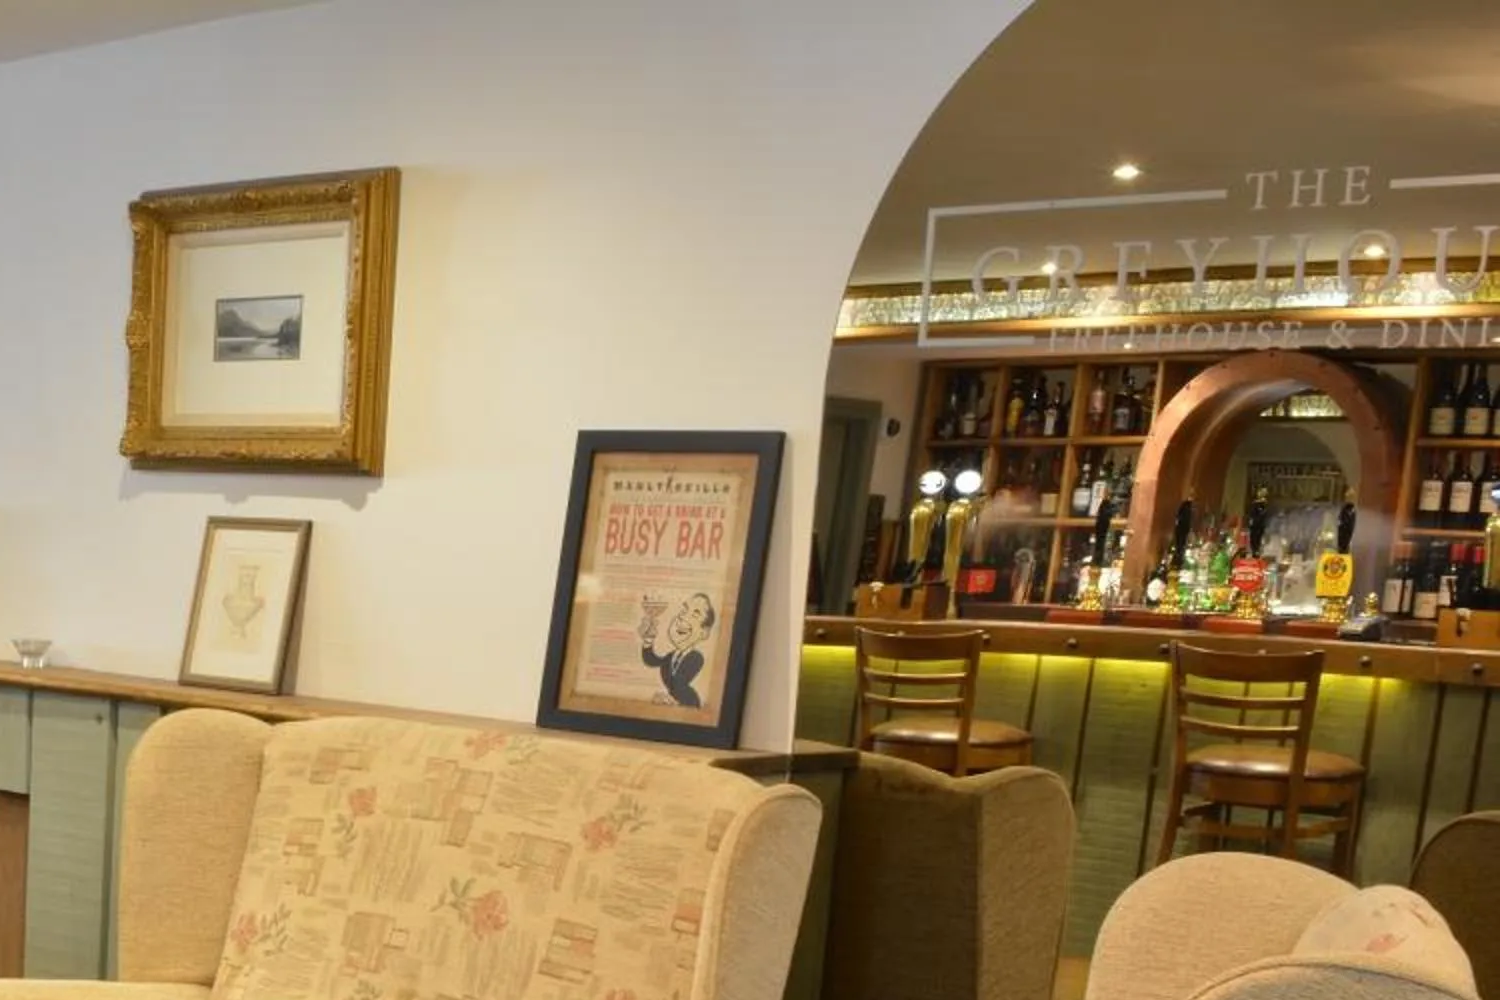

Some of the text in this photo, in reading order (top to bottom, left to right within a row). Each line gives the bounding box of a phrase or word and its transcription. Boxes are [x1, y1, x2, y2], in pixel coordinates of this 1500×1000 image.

[1245, 166, 1371, 210] THE
[1325, 319, 1354, 350] &
[605, 518, 724, 561] BUSY BAR
